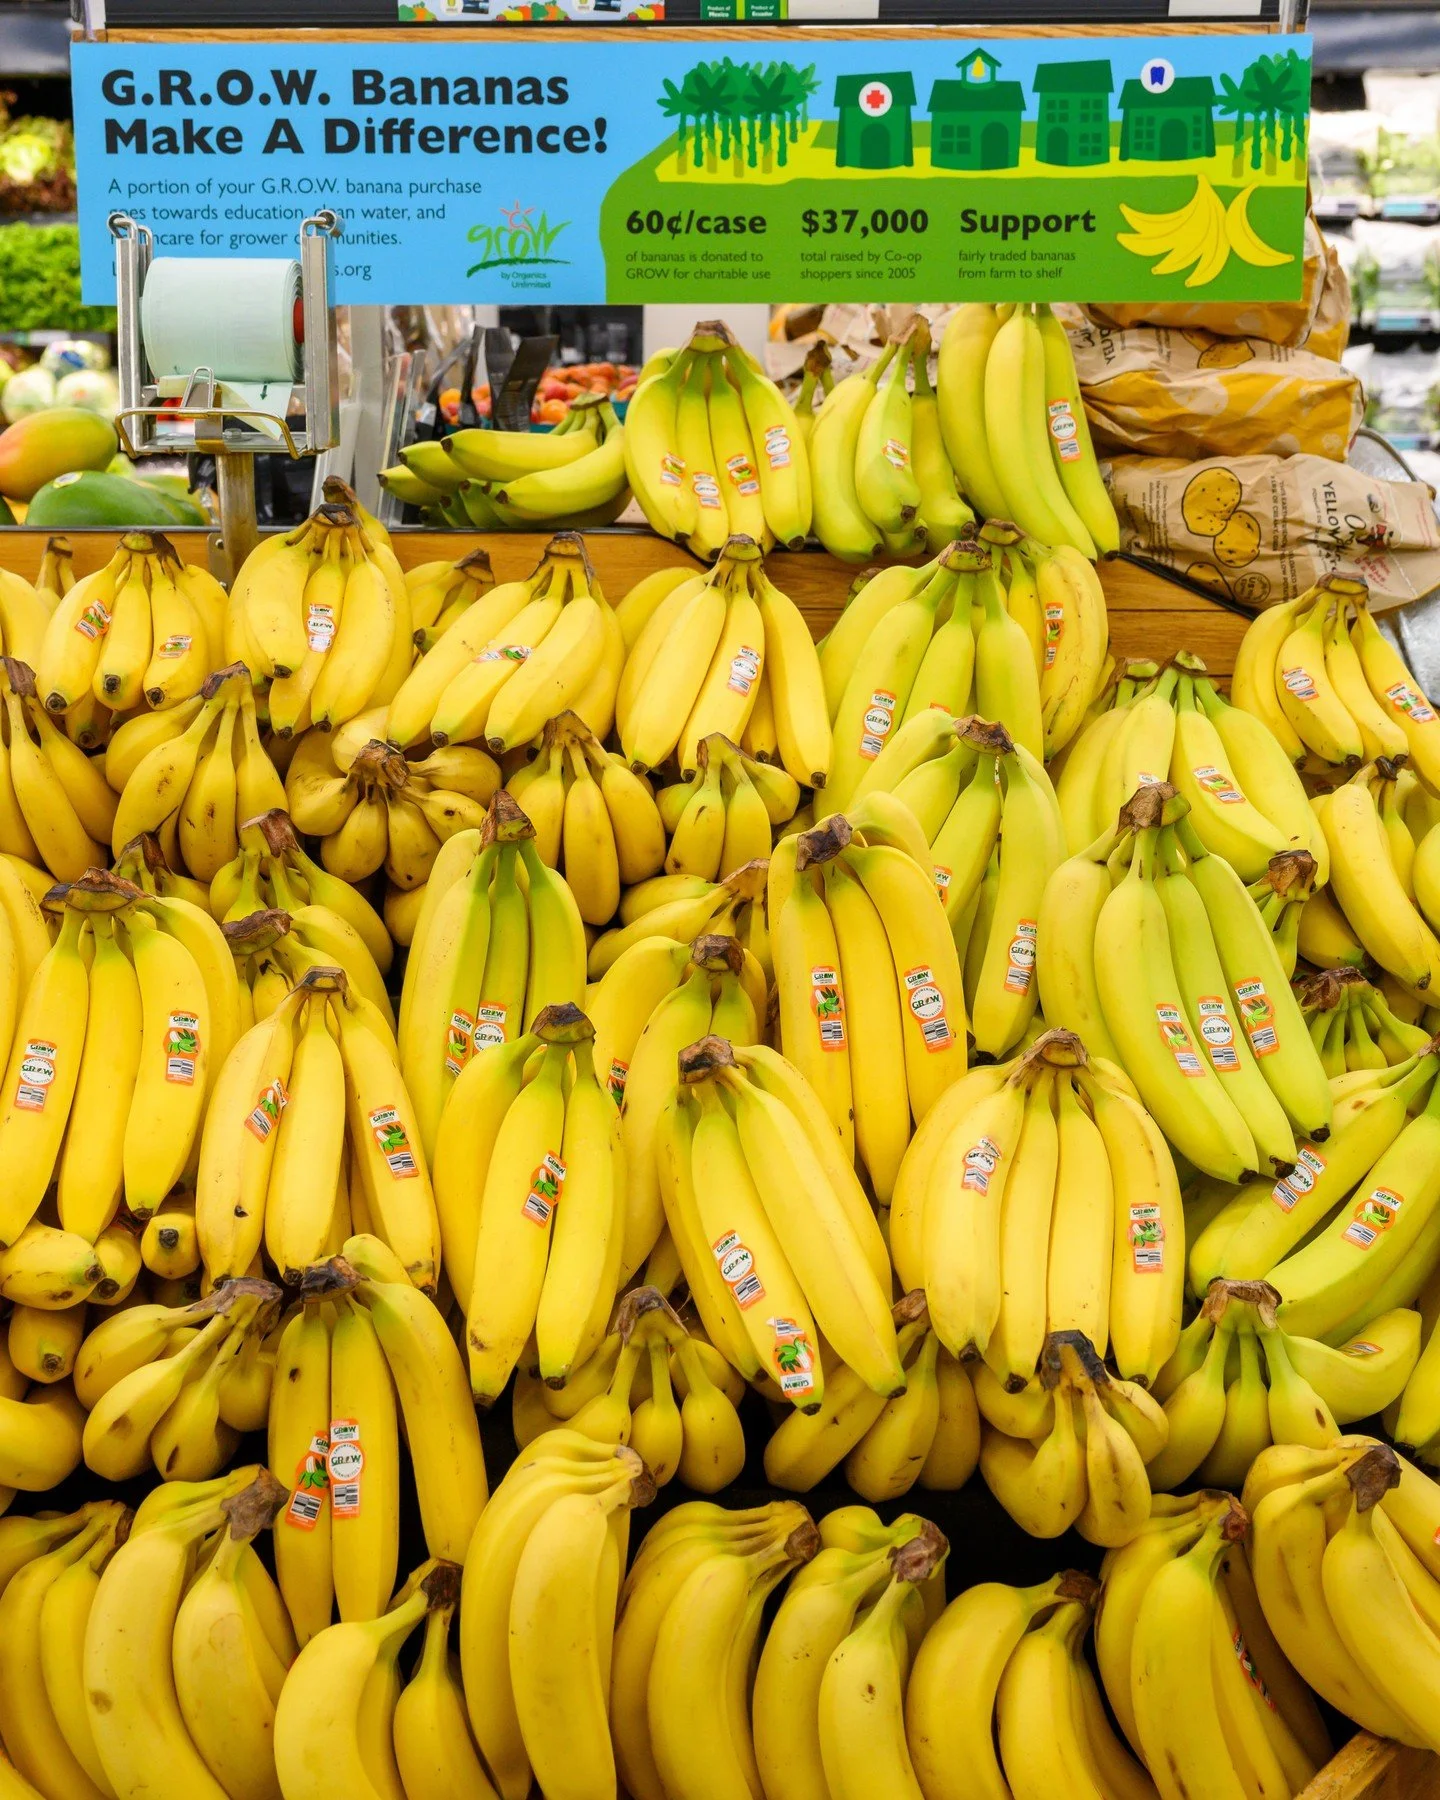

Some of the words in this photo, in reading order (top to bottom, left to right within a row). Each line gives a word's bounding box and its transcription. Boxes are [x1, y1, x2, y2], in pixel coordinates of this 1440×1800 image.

[101, 68, 331, 106] G.R.O.W.
[351, 69, 570, 106] Bananas
[104, 118, 243, 155] Make
[261, 118, 305, 155] A
[323, 116, 608, 155] Difference!
[108, 178, 122, 195] A
[127, 179, 190, 199] portion
[195, 177, 213, 195] of
[217, 182, 256, 199] your
[261, 177, 340, 195] G.R.O.W.
[345, 177, 403, 195] banana
[408, 177, 482, 199] purchase
[151, 203, 219, 221] towards
[360, 205, 411, 223] water,
[416, 203, 446, 220] and
[626, 209, 767, 241] 60¢/case
[801, 207, 929, 240] $37,000
[960, 208, 1097, 241] Support
[199, 228, 224, 246] for
[229, 233, 289, 250] grower
[467, 209, 572, 263] grow
[625, 250, 638, 262] of
[640, 251, 686, 263] bananas
[688, 251, 698, 263] is
[700, 250, 748, 263] donated
[750, 252, 764, 262] to
[800, 249, 827, 262] total
[830, 250, 864, 262] raised
[867, 250, 881, 265] by
[884, 250, 923, 265] Co-op
[958, 249, 986, 265] fairly
[989, 249, 1027, 262] traded
[1030, 249, 1076, 262] bananas
[500, 271, 511, 281] by
[511, 270, 547, 281] Organics
[625, 267, 670, 280] GROW
[673, 267, 690, 280] for
[693, 267, 749, 280] charitable
[751, 270, 771, 280] use
[800, 267, 852, 283] shoppers
[855, 267, 884, 280] since
[887, 267, 916, 280] 2005
[958, 266, 986, 279] from
[989, 266, 1017, 279] farm
[1019, 268, 1033, 279] to
[1035, 266, 1063, 279] shelf
[511, 280, 551, 290] Unlimited
[874, 694, 893, 705] GROW
[865, 714, 890, 727] GROW
[813, 972, 834, 980] GROW
[906, 970, 929, 984] GROW
[1237, 983, 1261, 995] GROW
[911, 993, 941, 1011] GROW
[480, 1008, 503, 1018] GROW
[173, 1016, 197, 1024] GROW
[453, 1014, 472, 1029] GROW
[1202, 1025, 1230, 1035] GROW
[473, 1032, 502, 1043] GROW
[29, 1043, 55, 1054] GROW
[21, 1063, 54, 1076] GROW
[371, 1110, 396, 1122] GROW
[1301, 1149, 1321, 1169] GROW
[1375, 1190, 1398, 1206] GROW
[1132, 1207, 1157, 1215] GROW
[716, 1234, 737, 1253] GROW
[722, 1252, 749, 1275] GROW
[333, 1425, 357, 1433] GROW
[331, 1453, 361, 1466] GROW
